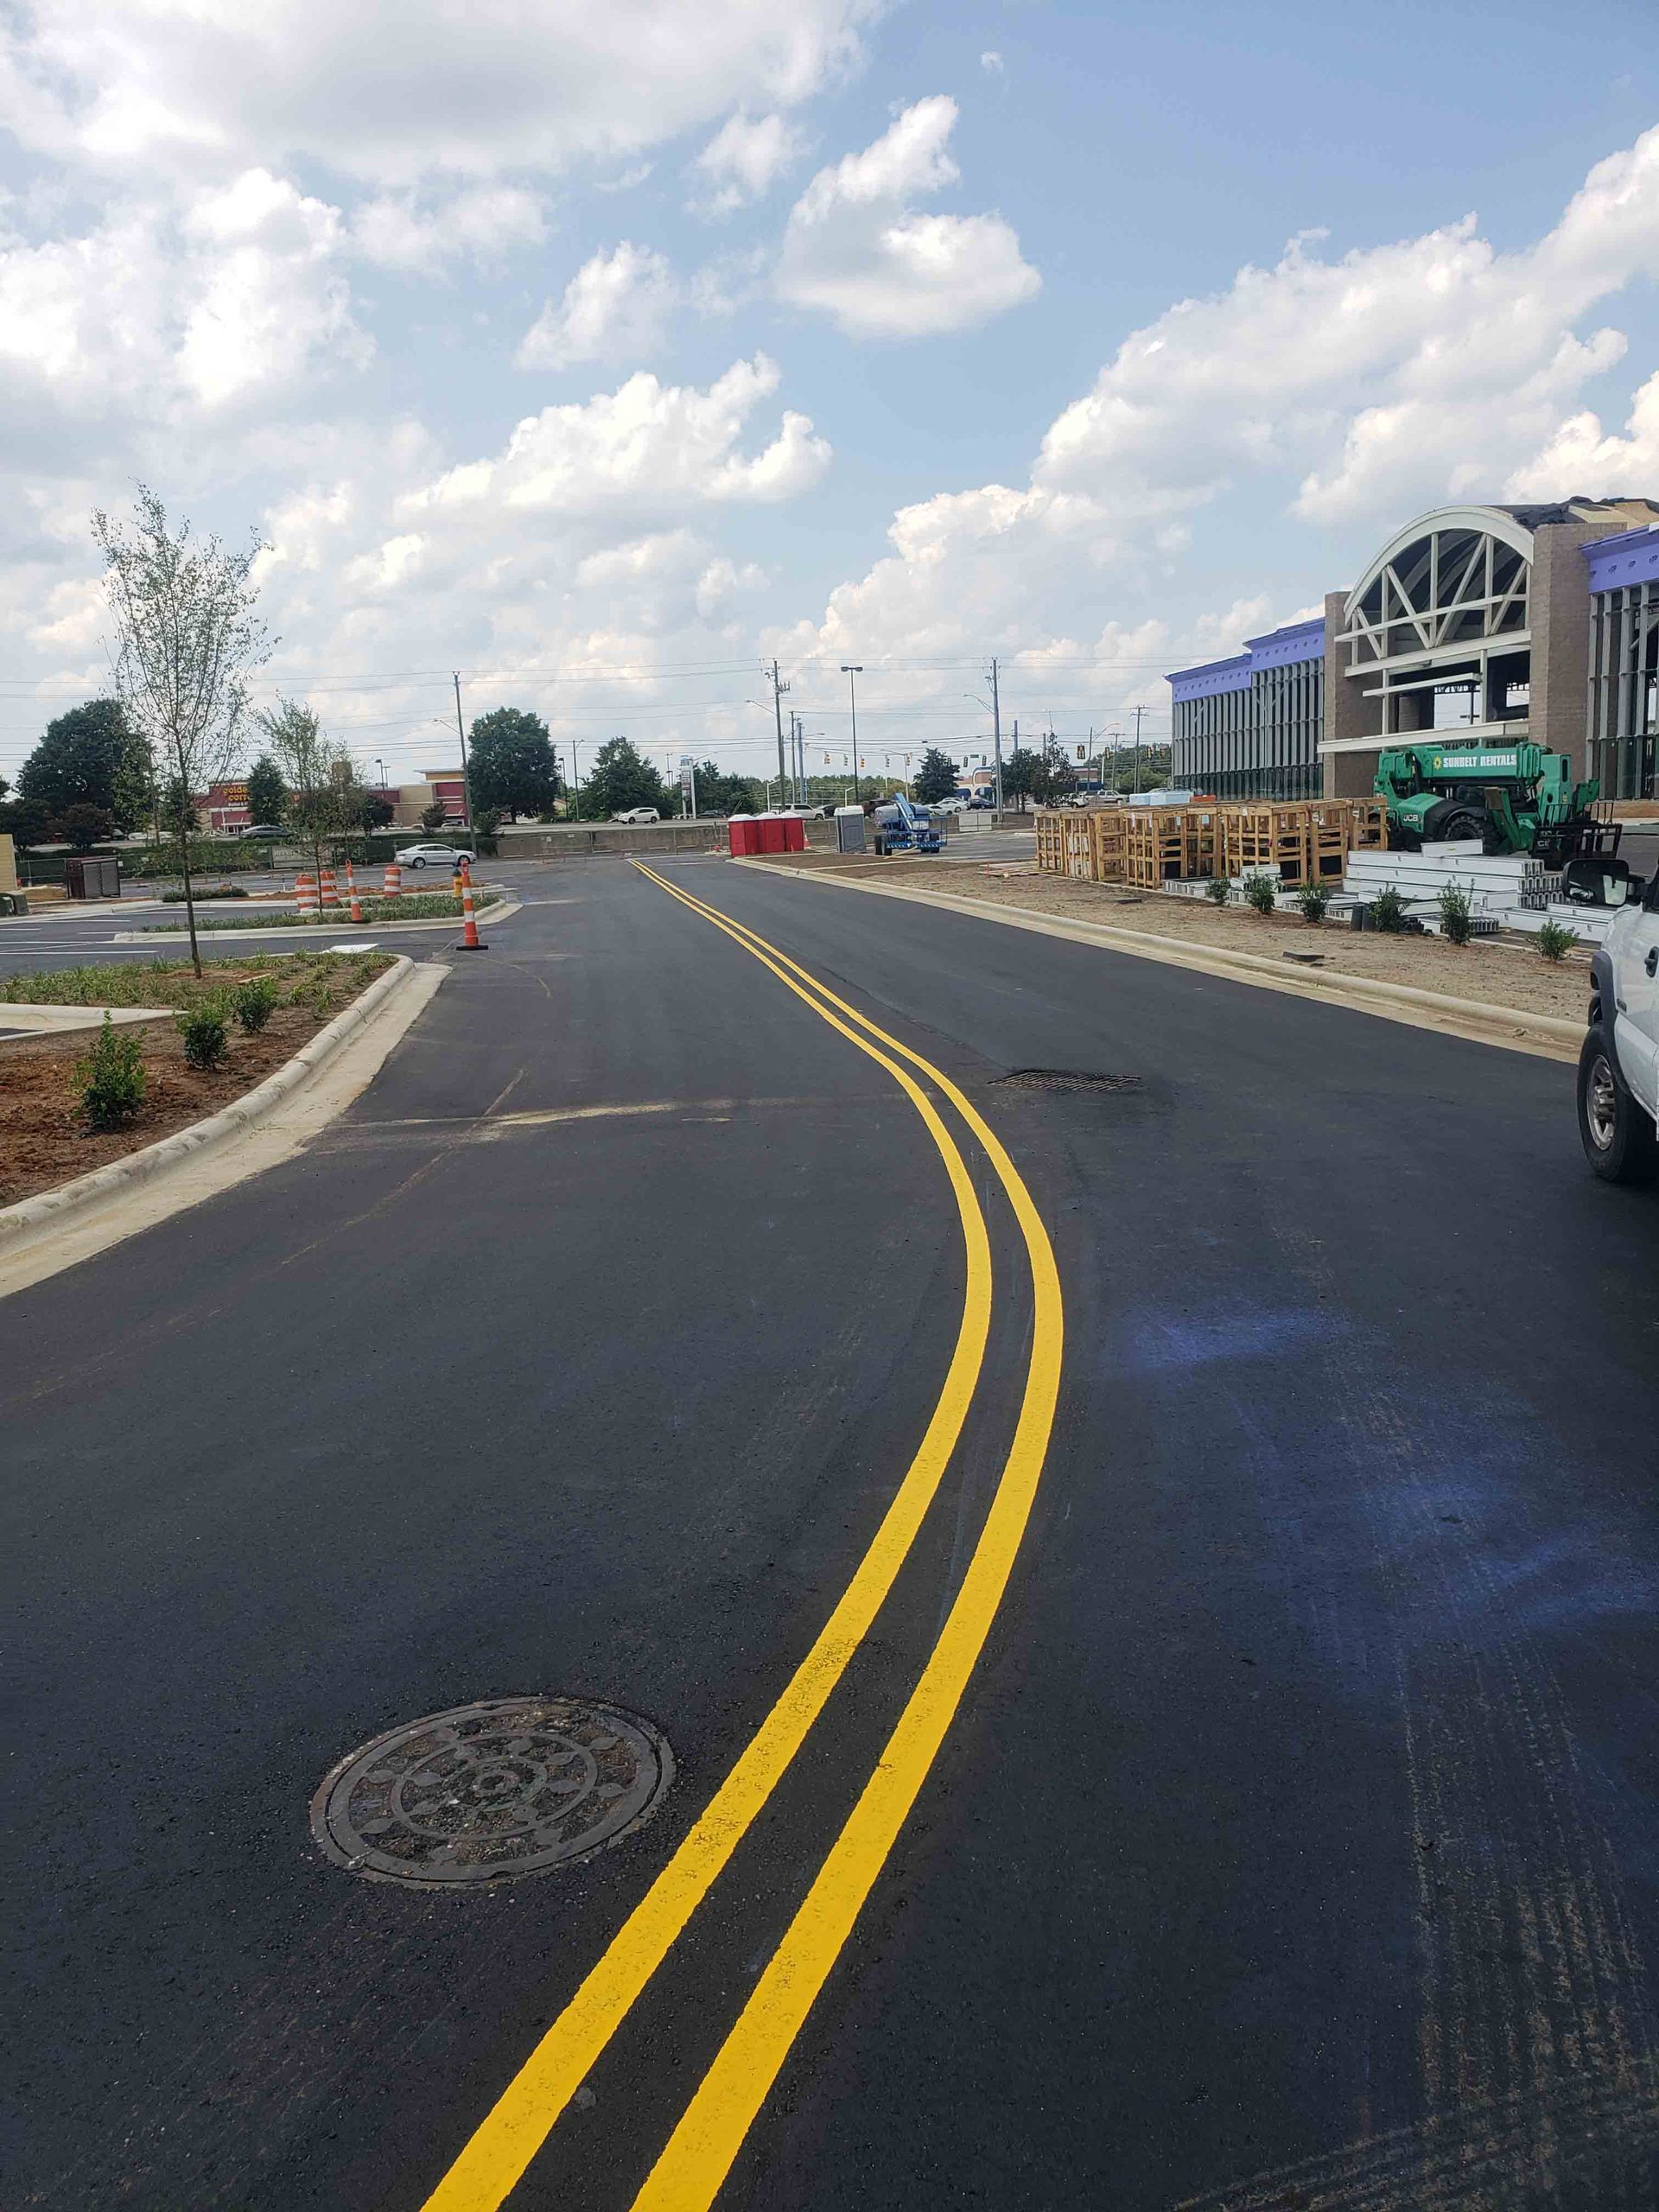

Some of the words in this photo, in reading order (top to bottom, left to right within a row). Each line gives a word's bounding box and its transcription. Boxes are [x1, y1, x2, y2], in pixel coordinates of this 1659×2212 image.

[1443, 756, 1478, 768] SUNBELT
[1480, 754, 1516, 767] RENTALS
[222, 785, 249, 797] golde
